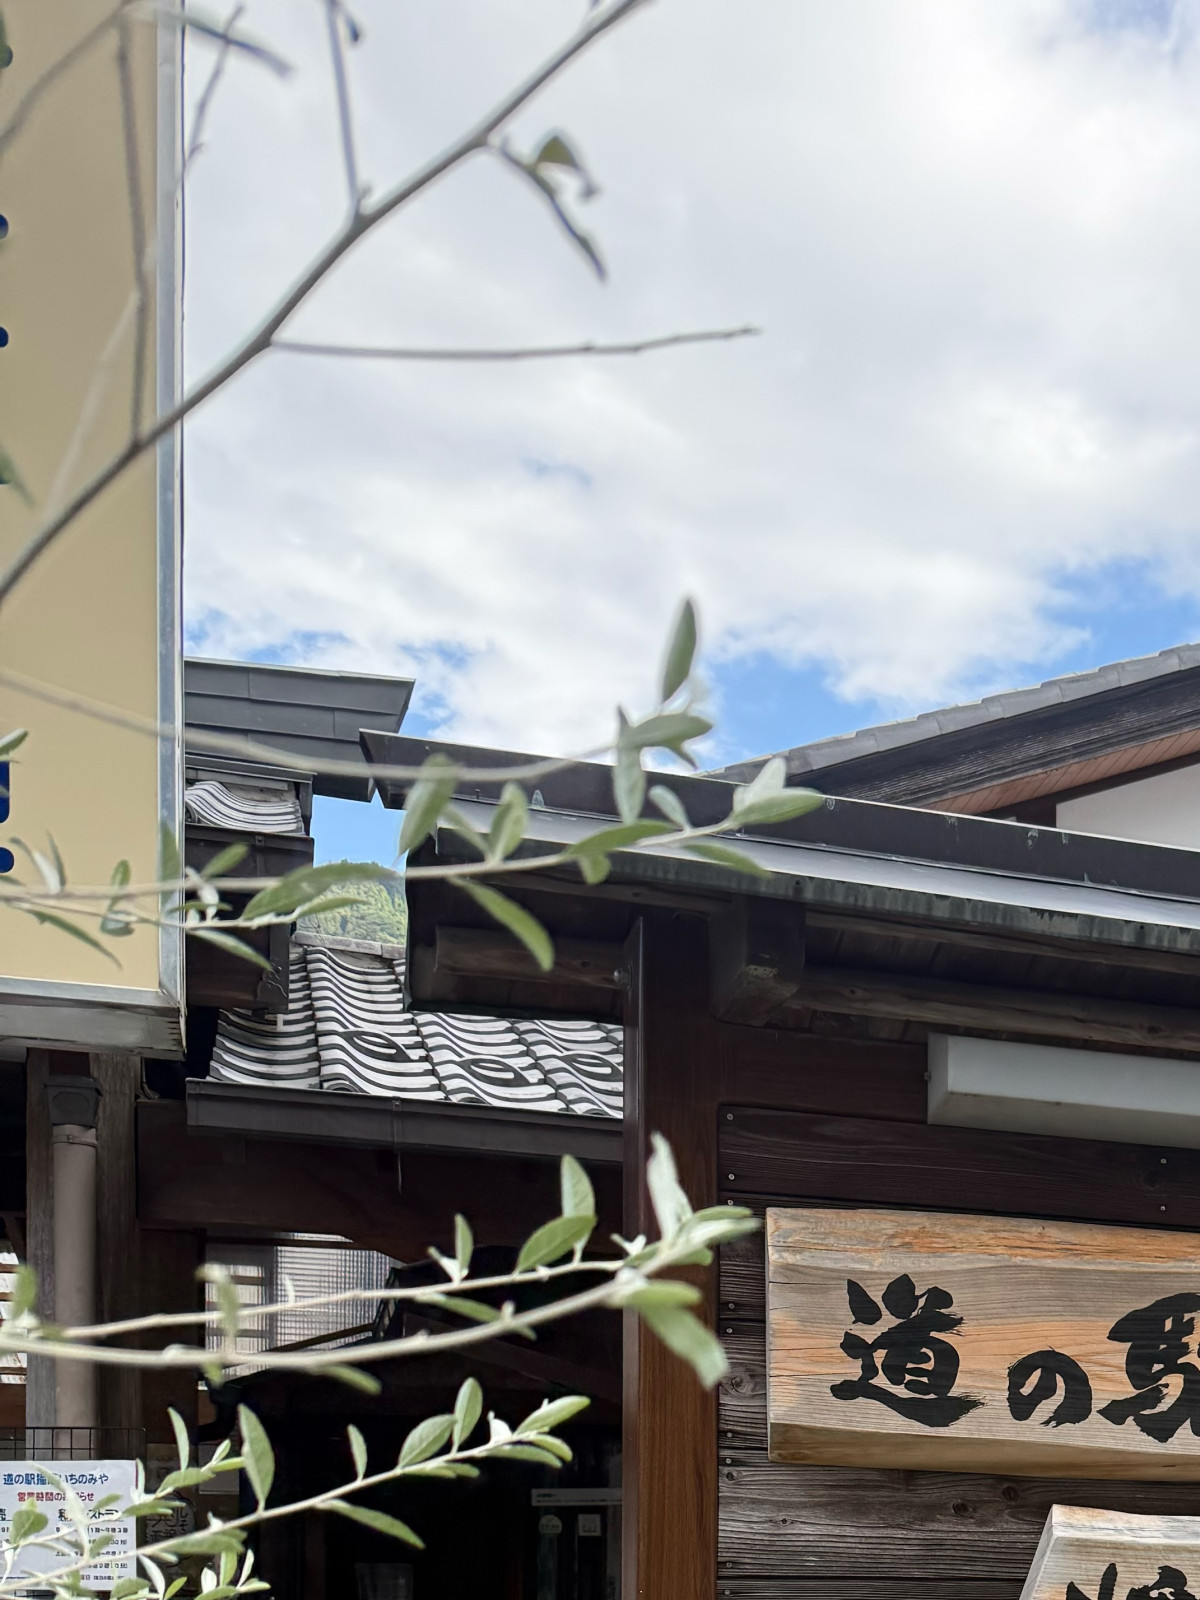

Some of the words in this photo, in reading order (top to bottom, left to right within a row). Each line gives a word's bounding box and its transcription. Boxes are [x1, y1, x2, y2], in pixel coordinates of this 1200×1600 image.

[3, 1473, 109, 1486] 道の駅播いちのみや
[17, 1491, 95, 1502] 営業時間のらせ
